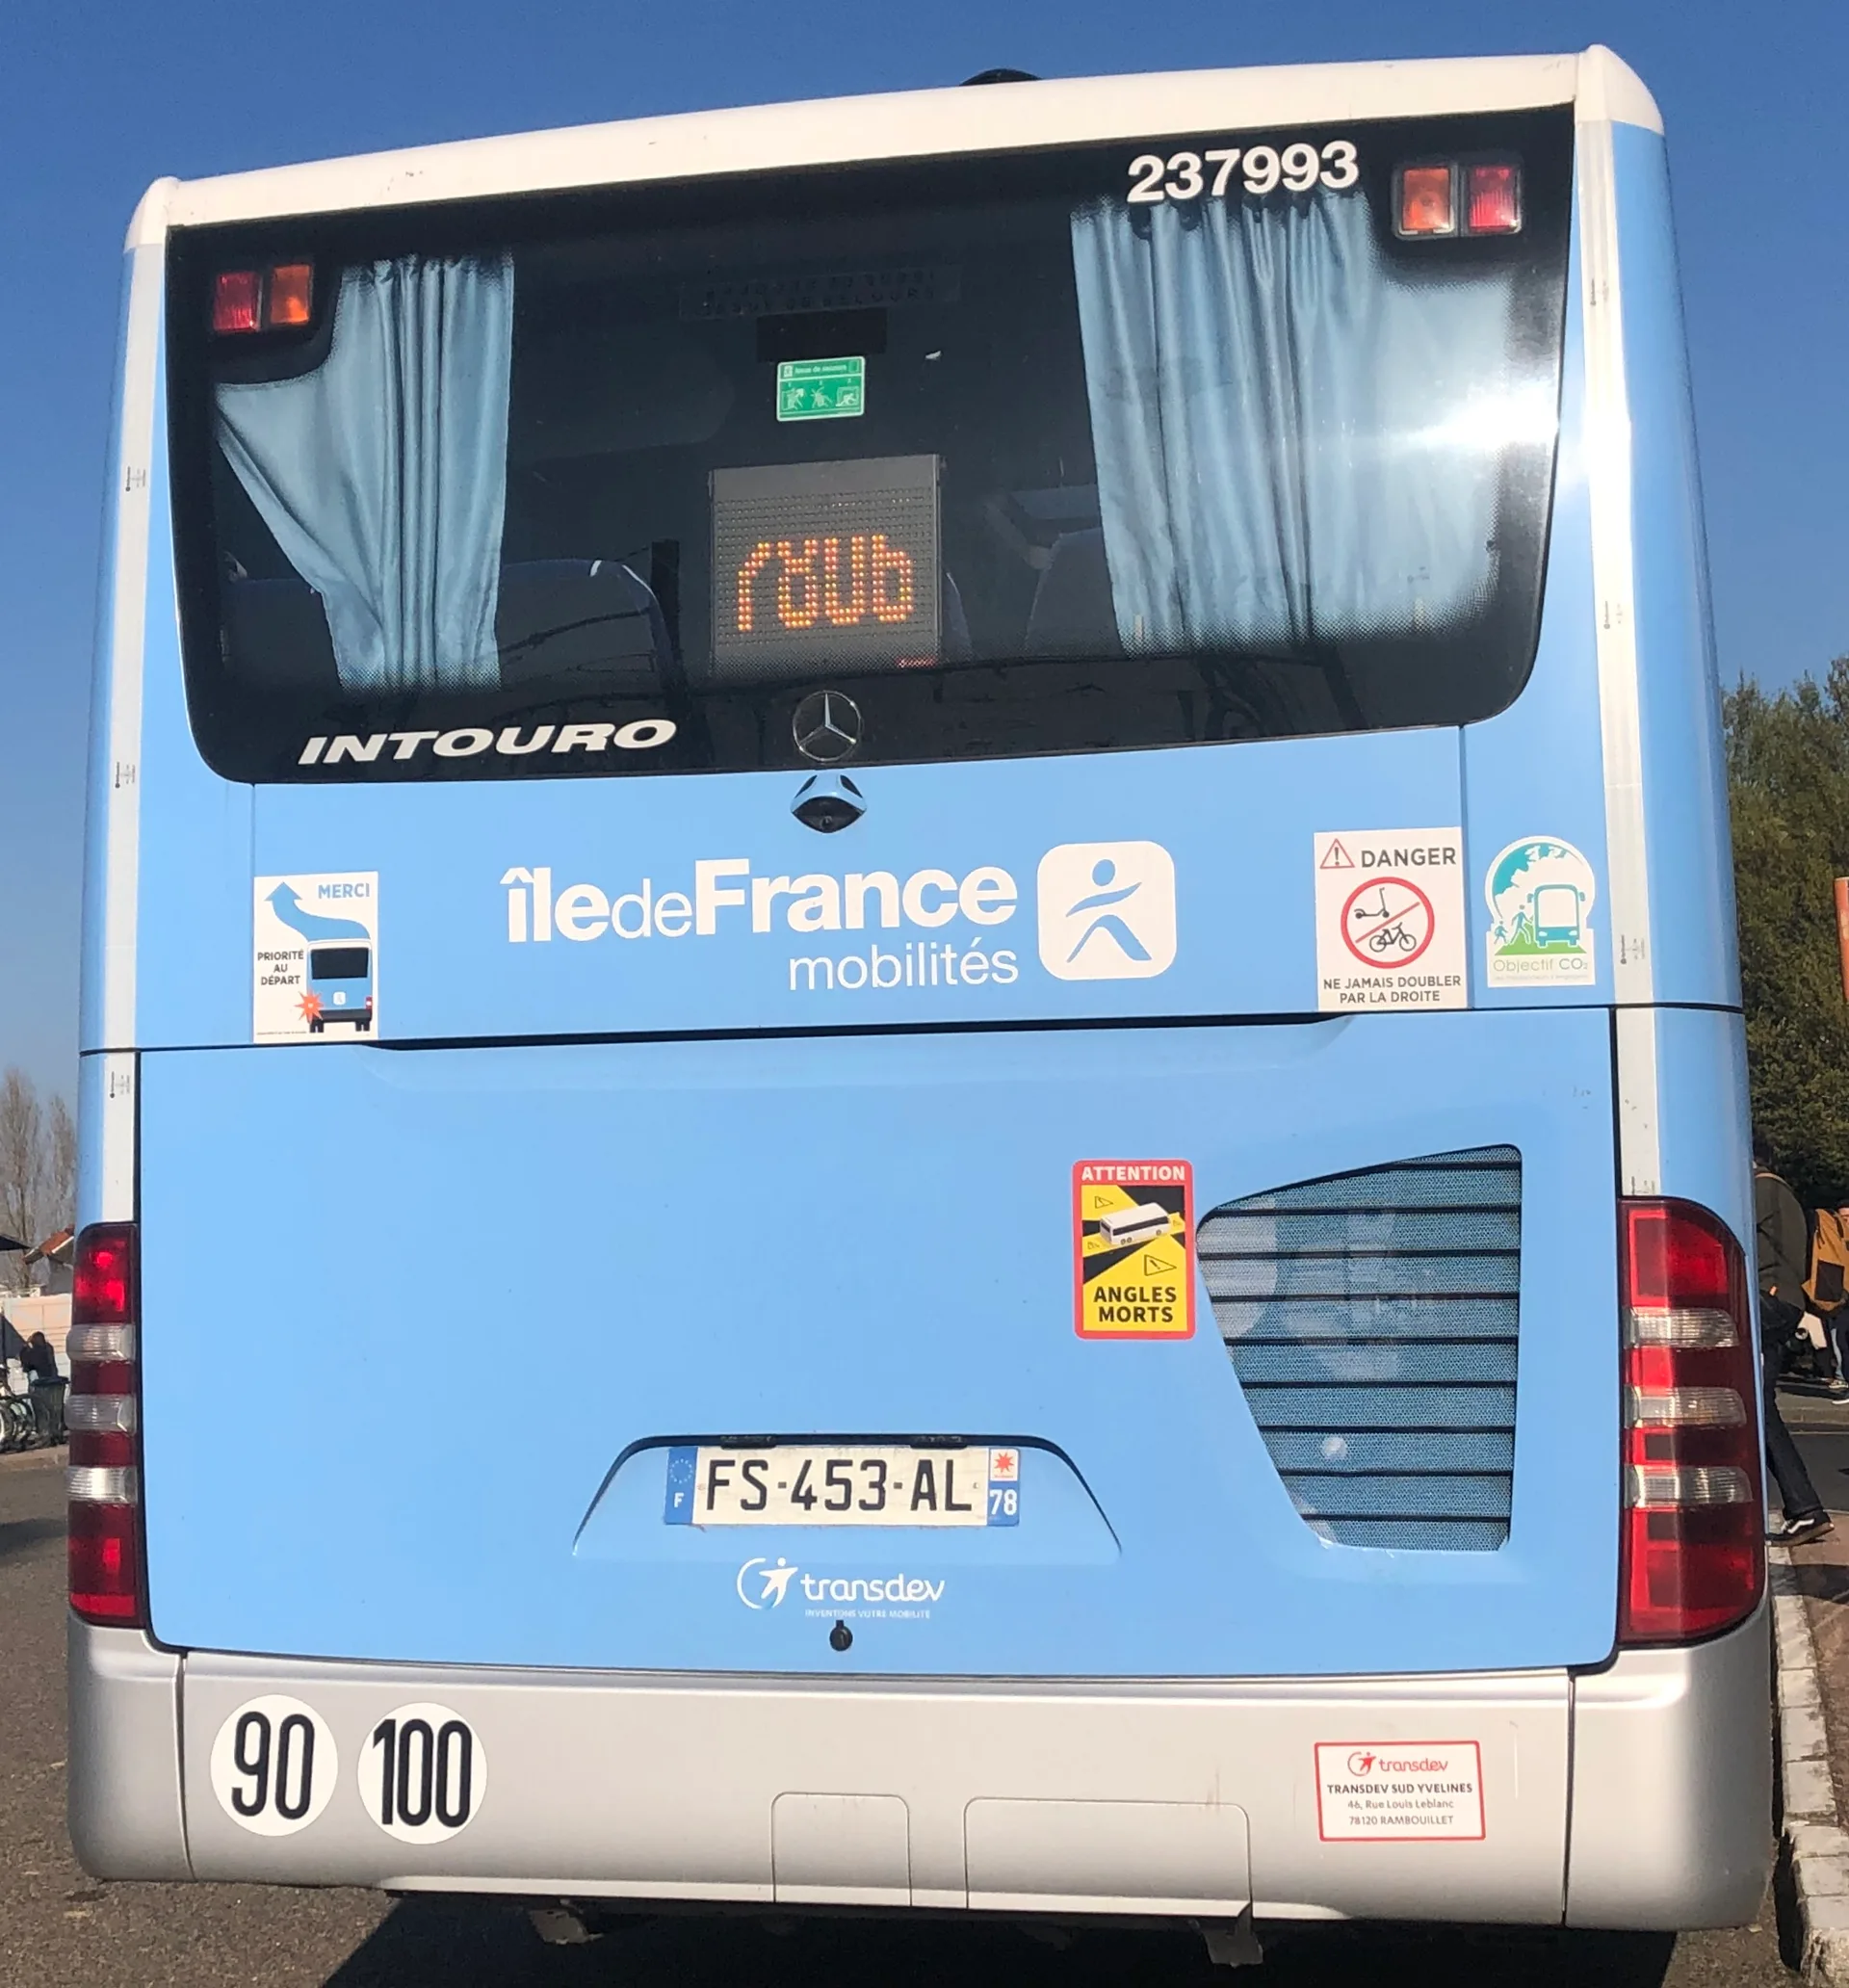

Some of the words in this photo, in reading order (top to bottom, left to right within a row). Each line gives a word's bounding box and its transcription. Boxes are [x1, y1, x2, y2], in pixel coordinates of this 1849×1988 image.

[1127, 140, 1360, 202] 237993
[298, 719, 677, 765] INTOURO
[1361, 847, 1456, 869] DANGER
[318, 883, 370, 899] MERCI
[257, 949, 304, 961] PRIORITÉ
[273, 963, 288, 973] AU
[788, 937, 1020, 992] mobilités
[1493, 958, 1554, 974] Objectif
[260, 975, 300, 986] DÉPART
[1323, 979, 1341, 990] NE
[1344, 977, 1395, 989] JAMAIS
[1397, 975, 1461, 988] DOUBLER
[1340, 992, 1367, 1004] PAR
[1369, 991, 1388, 1003] LA
[1391, 990, 1441, 1003] DROITE
[1081, 1165, 1185, 1181] ATTENTION
[1094, 1286, 1177, 1303] ANGLES
[1099, 1306, 1173, 1322] MORTS
[674, 1492, 684, 1507] F
[706, 1458, 973, 1511] FS-453-AL
[989, 1488, 1017, 1515] 78
[800, 1573, 946, 1602] transdev
[231, 1711, 316, 1819] 90
[373, 1718, 473, 1828] 100
[1378, 1758, 1448, 1772] transdev
[1327, 1784, 1389, 1794] TRANSDEV
[1392, 1783, 1415, 1793] SUD
[1417, 1783, 1472, 1793] YVELINES
[1366, 1799, 1384, 1809] Rue
[1387, 1798, 1413, 1809] Louis
[1416, 1798, 1454, 1809] Leblanc
[1349, 1816, 1378, 1825] 78120
[1380, 1815, 1454, 1825] RAMBOUILLET
